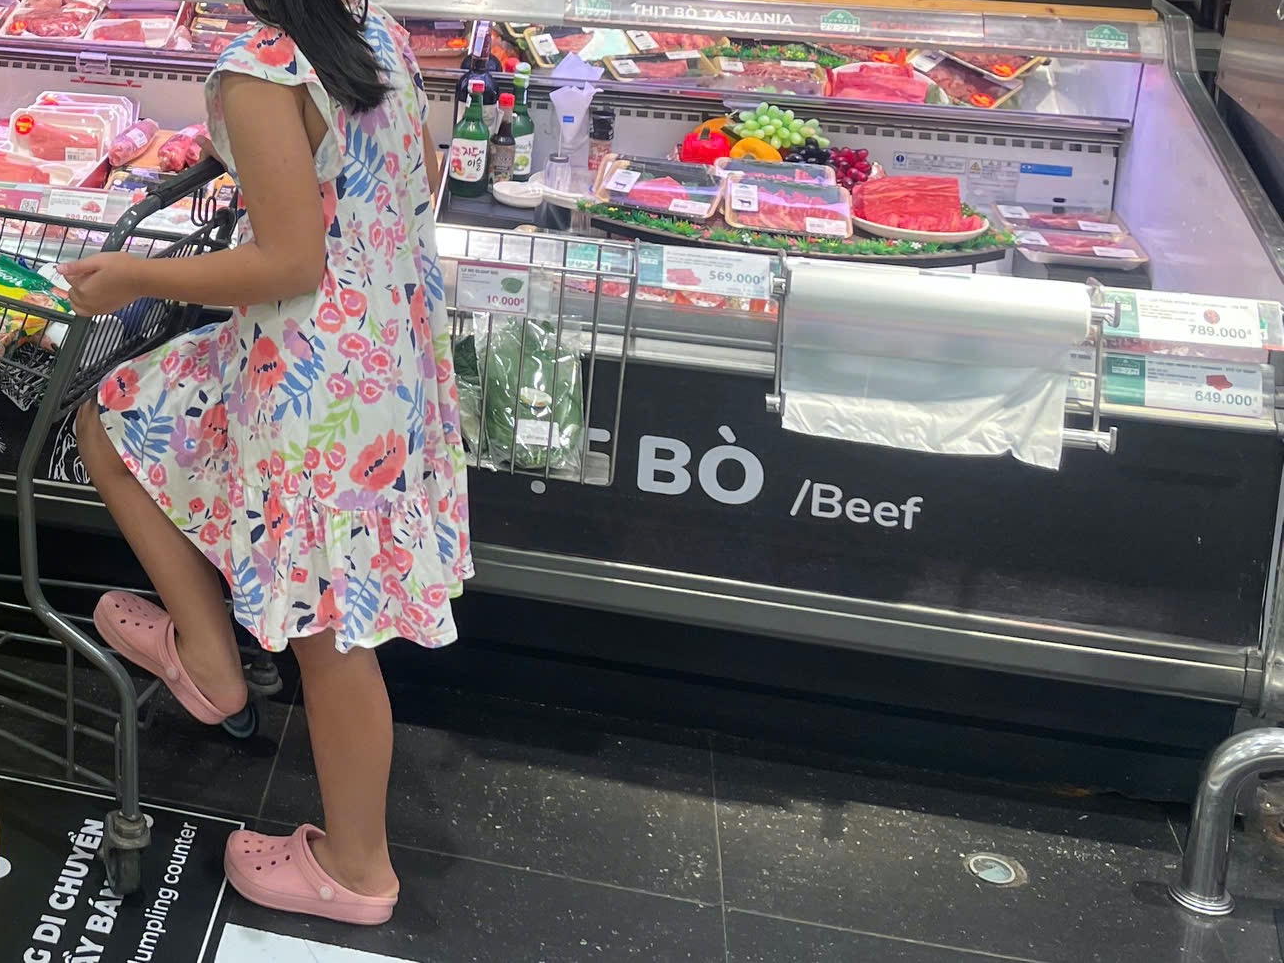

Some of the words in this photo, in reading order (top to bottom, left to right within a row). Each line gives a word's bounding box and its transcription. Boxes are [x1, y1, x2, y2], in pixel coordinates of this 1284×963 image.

[632, 2, 671, 19] THỊT
[673, 5, 698, 19] BÒ
[701, 9, 795, 26] TASMANIA
[637, 423, 764, 506] BÒ
[790, 478, 923, 535] /Beef
[47, 818, 104, 911] CHUYỂN
[163, 821, 198, 885] counter
